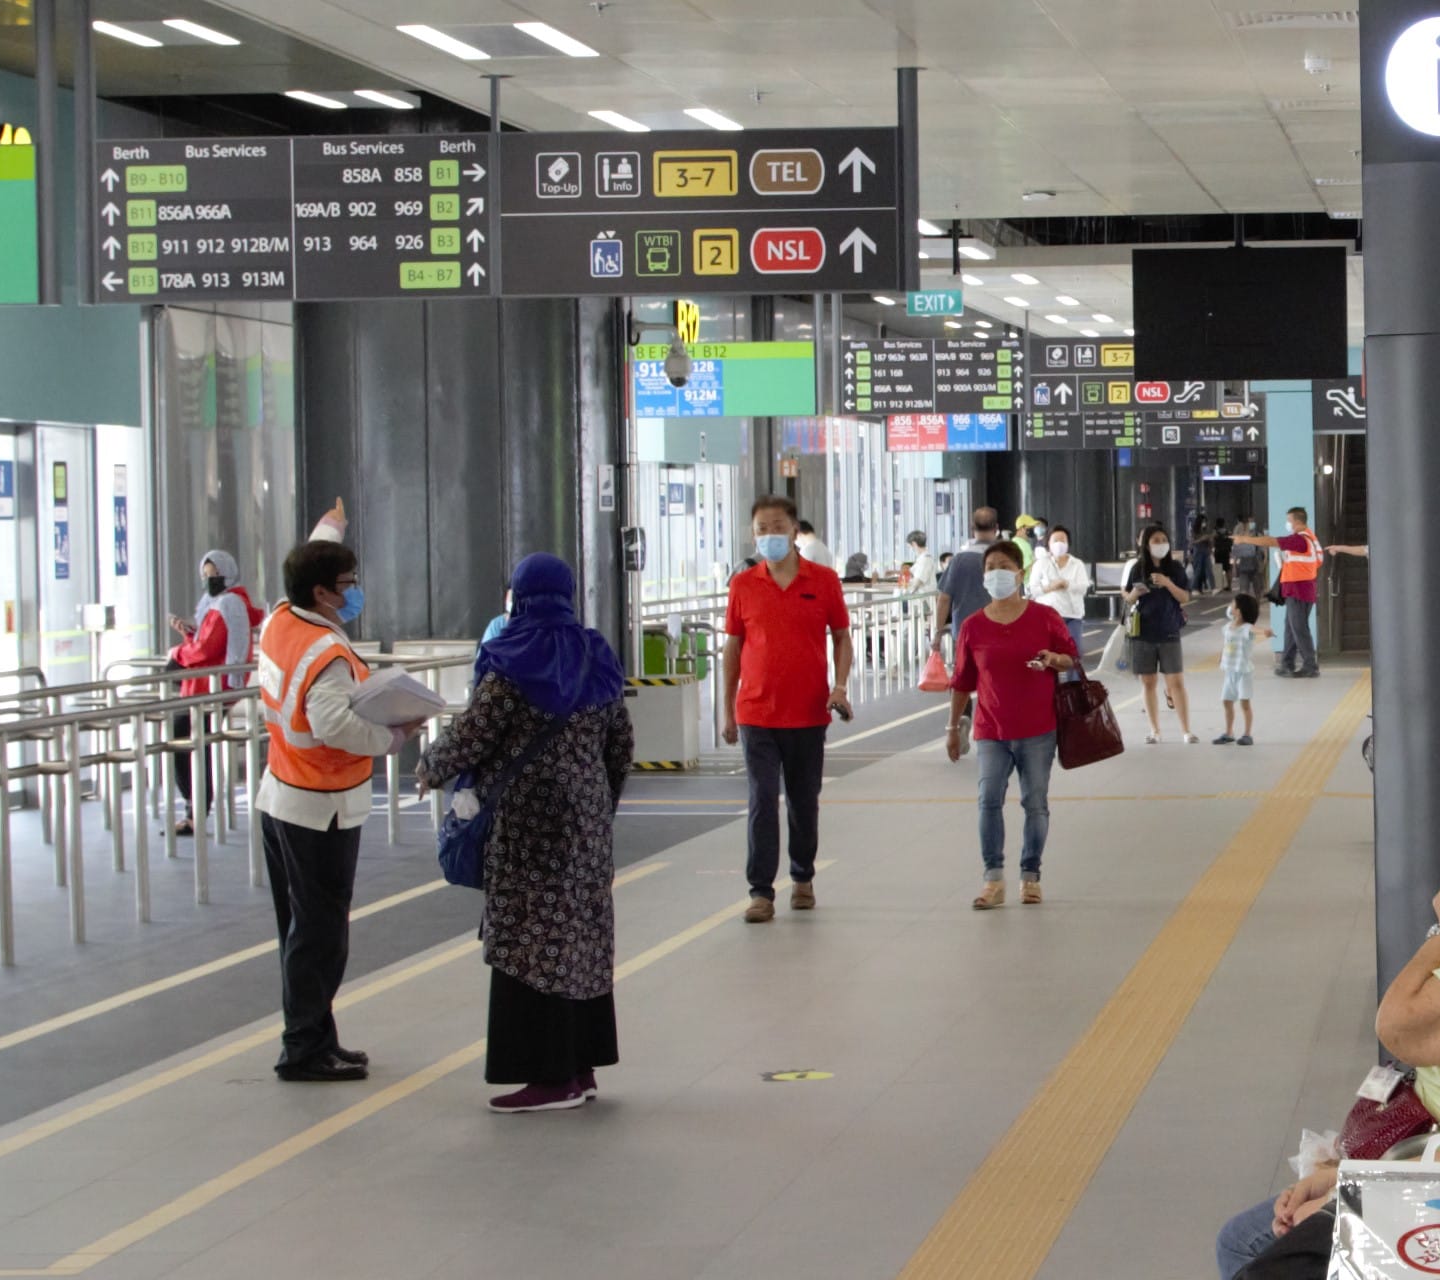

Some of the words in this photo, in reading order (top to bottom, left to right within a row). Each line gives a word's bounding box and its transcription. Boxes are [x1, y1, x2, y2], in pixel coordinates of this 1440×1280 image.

[113, 146, 149, 160] Berth
[185, 145, 209, 158] Bus
[212, 144, 267, 158] Services
[322, 142, 347, 155] Bus
[350, 141, 404, 154] Services
[440, 140, 476, 153] Berth
[342, 168, 382, 183] 858A
[394, 168, 422, 182] 858
[767, 161, 808, 182] TEL
[542, 183, 577, 195] Top-Up
[613, 181, 632, 192] Info
[295, 202, 340, 217] 169A/B
[348, 202, 376, 216] 902
[394, 201, 423, 215] 969
[162, 240, 188, 254] 911
[197, 239, 224, 253] 912
[231, 237, 289, 253] 912B/M
[303, 237, 331, 251] 913
[349, 236, 377, 250] 964
[395, 235, 424, 250] 926
[644, 235, 673, 246] WTBI
[709, 246, 722, 266] 2
[767, 240, 810, 261] NSL
[202, 273, 230, 287] 913
[242, 272, 285, 286] 913M
[914, 294, 946, 312] EXIT
[636, 346, 695, 359] BERH
[704, 346, 727, 358] B12
[693, 362, 714, 373] 12B
[684, 390, 716, 401] 912M
[1142, 387, 1163, 397] NSL
[874, 400, 886, 408] 911
[890, 400, 903, 408] 912
